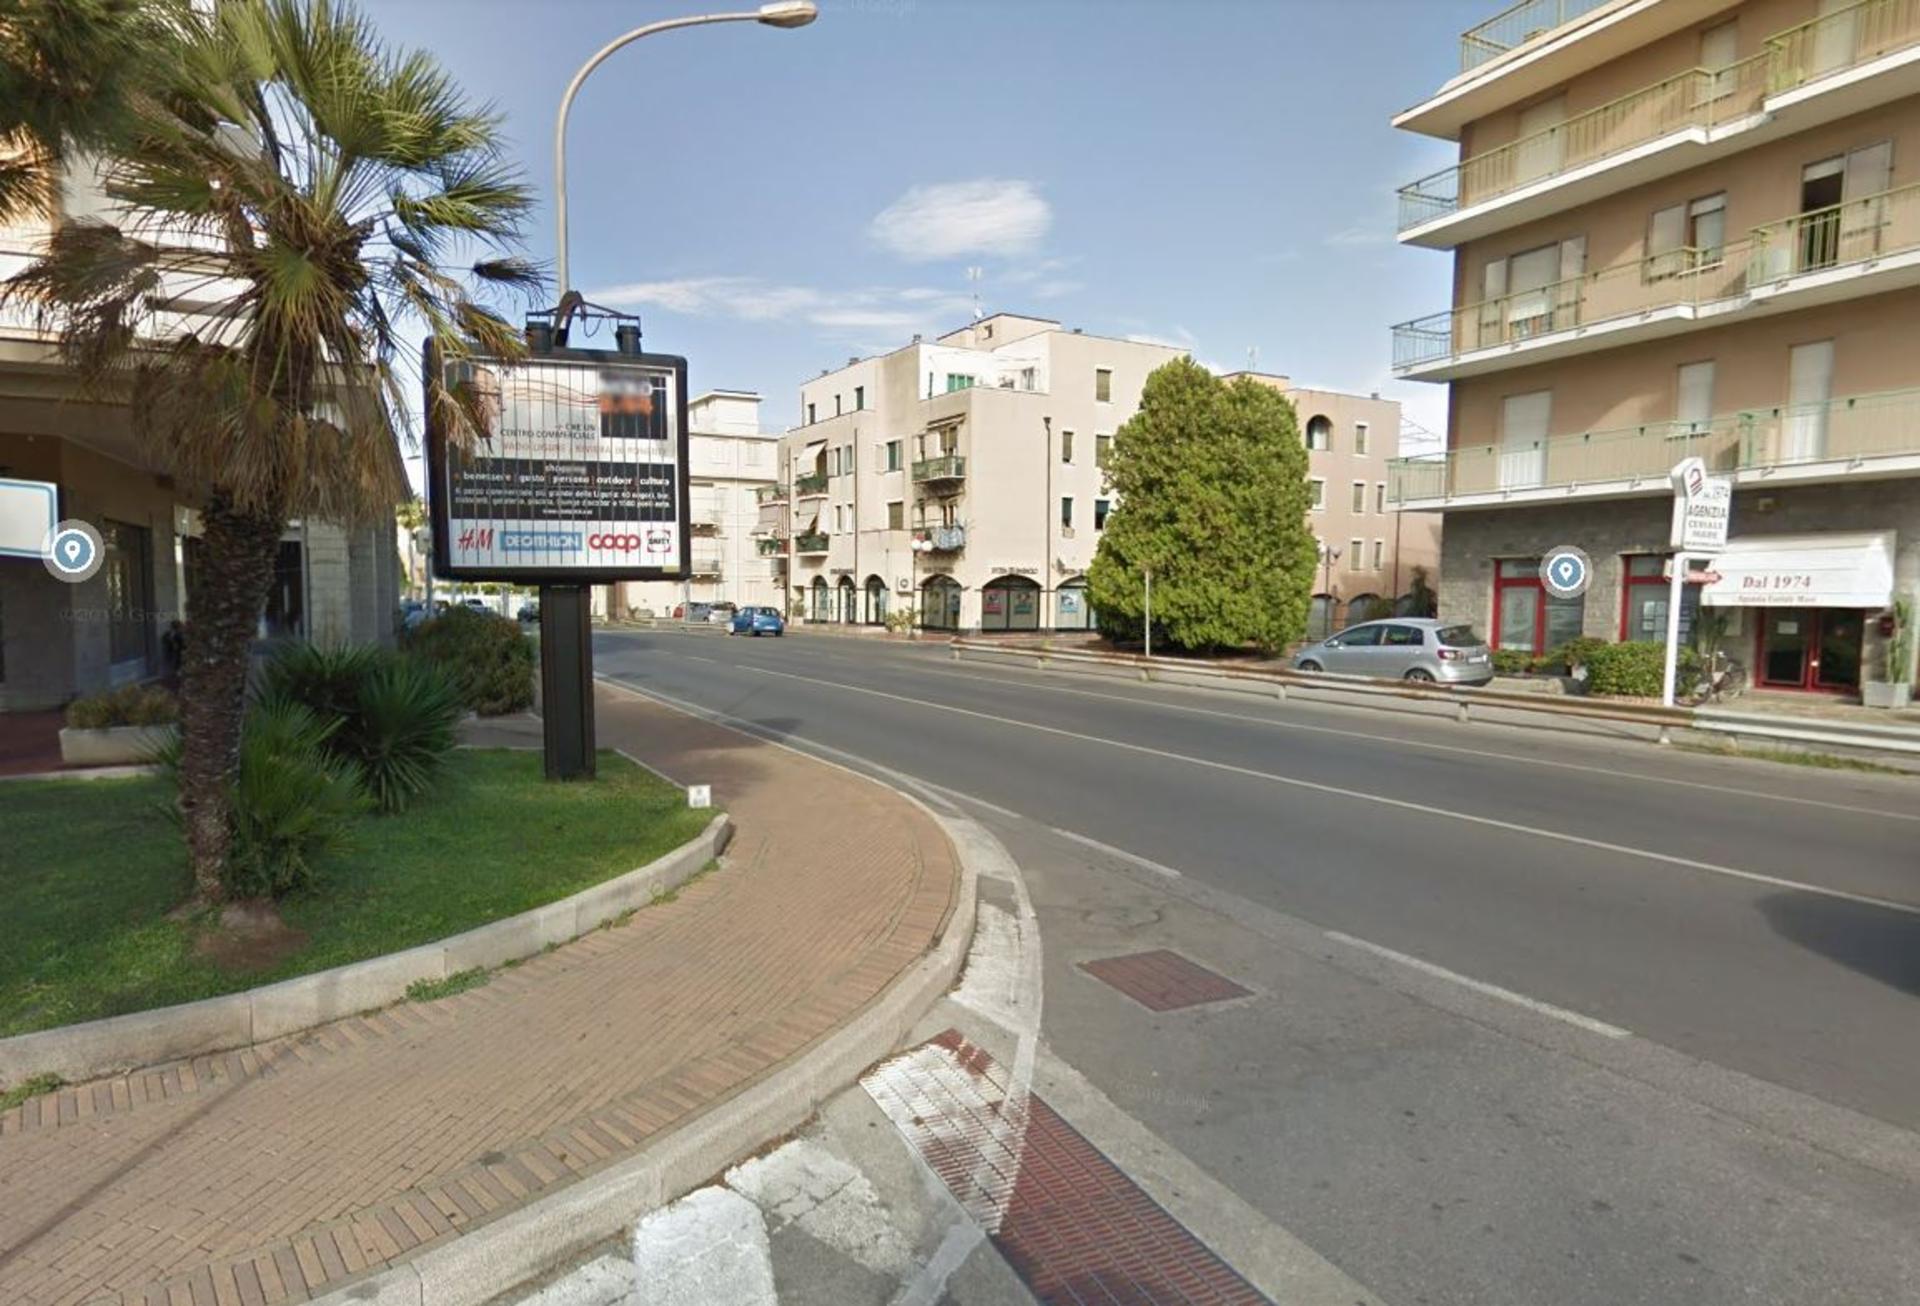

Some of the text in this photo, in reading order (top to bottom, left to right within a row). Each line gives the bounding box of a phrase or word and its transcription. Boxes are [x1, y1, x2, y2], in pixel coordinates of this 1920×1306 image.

[596, 475, 632, 485] outdoor
[457, 528, 495, 551] H&M
[1742, 575, 1811, 589] Dal 1974
